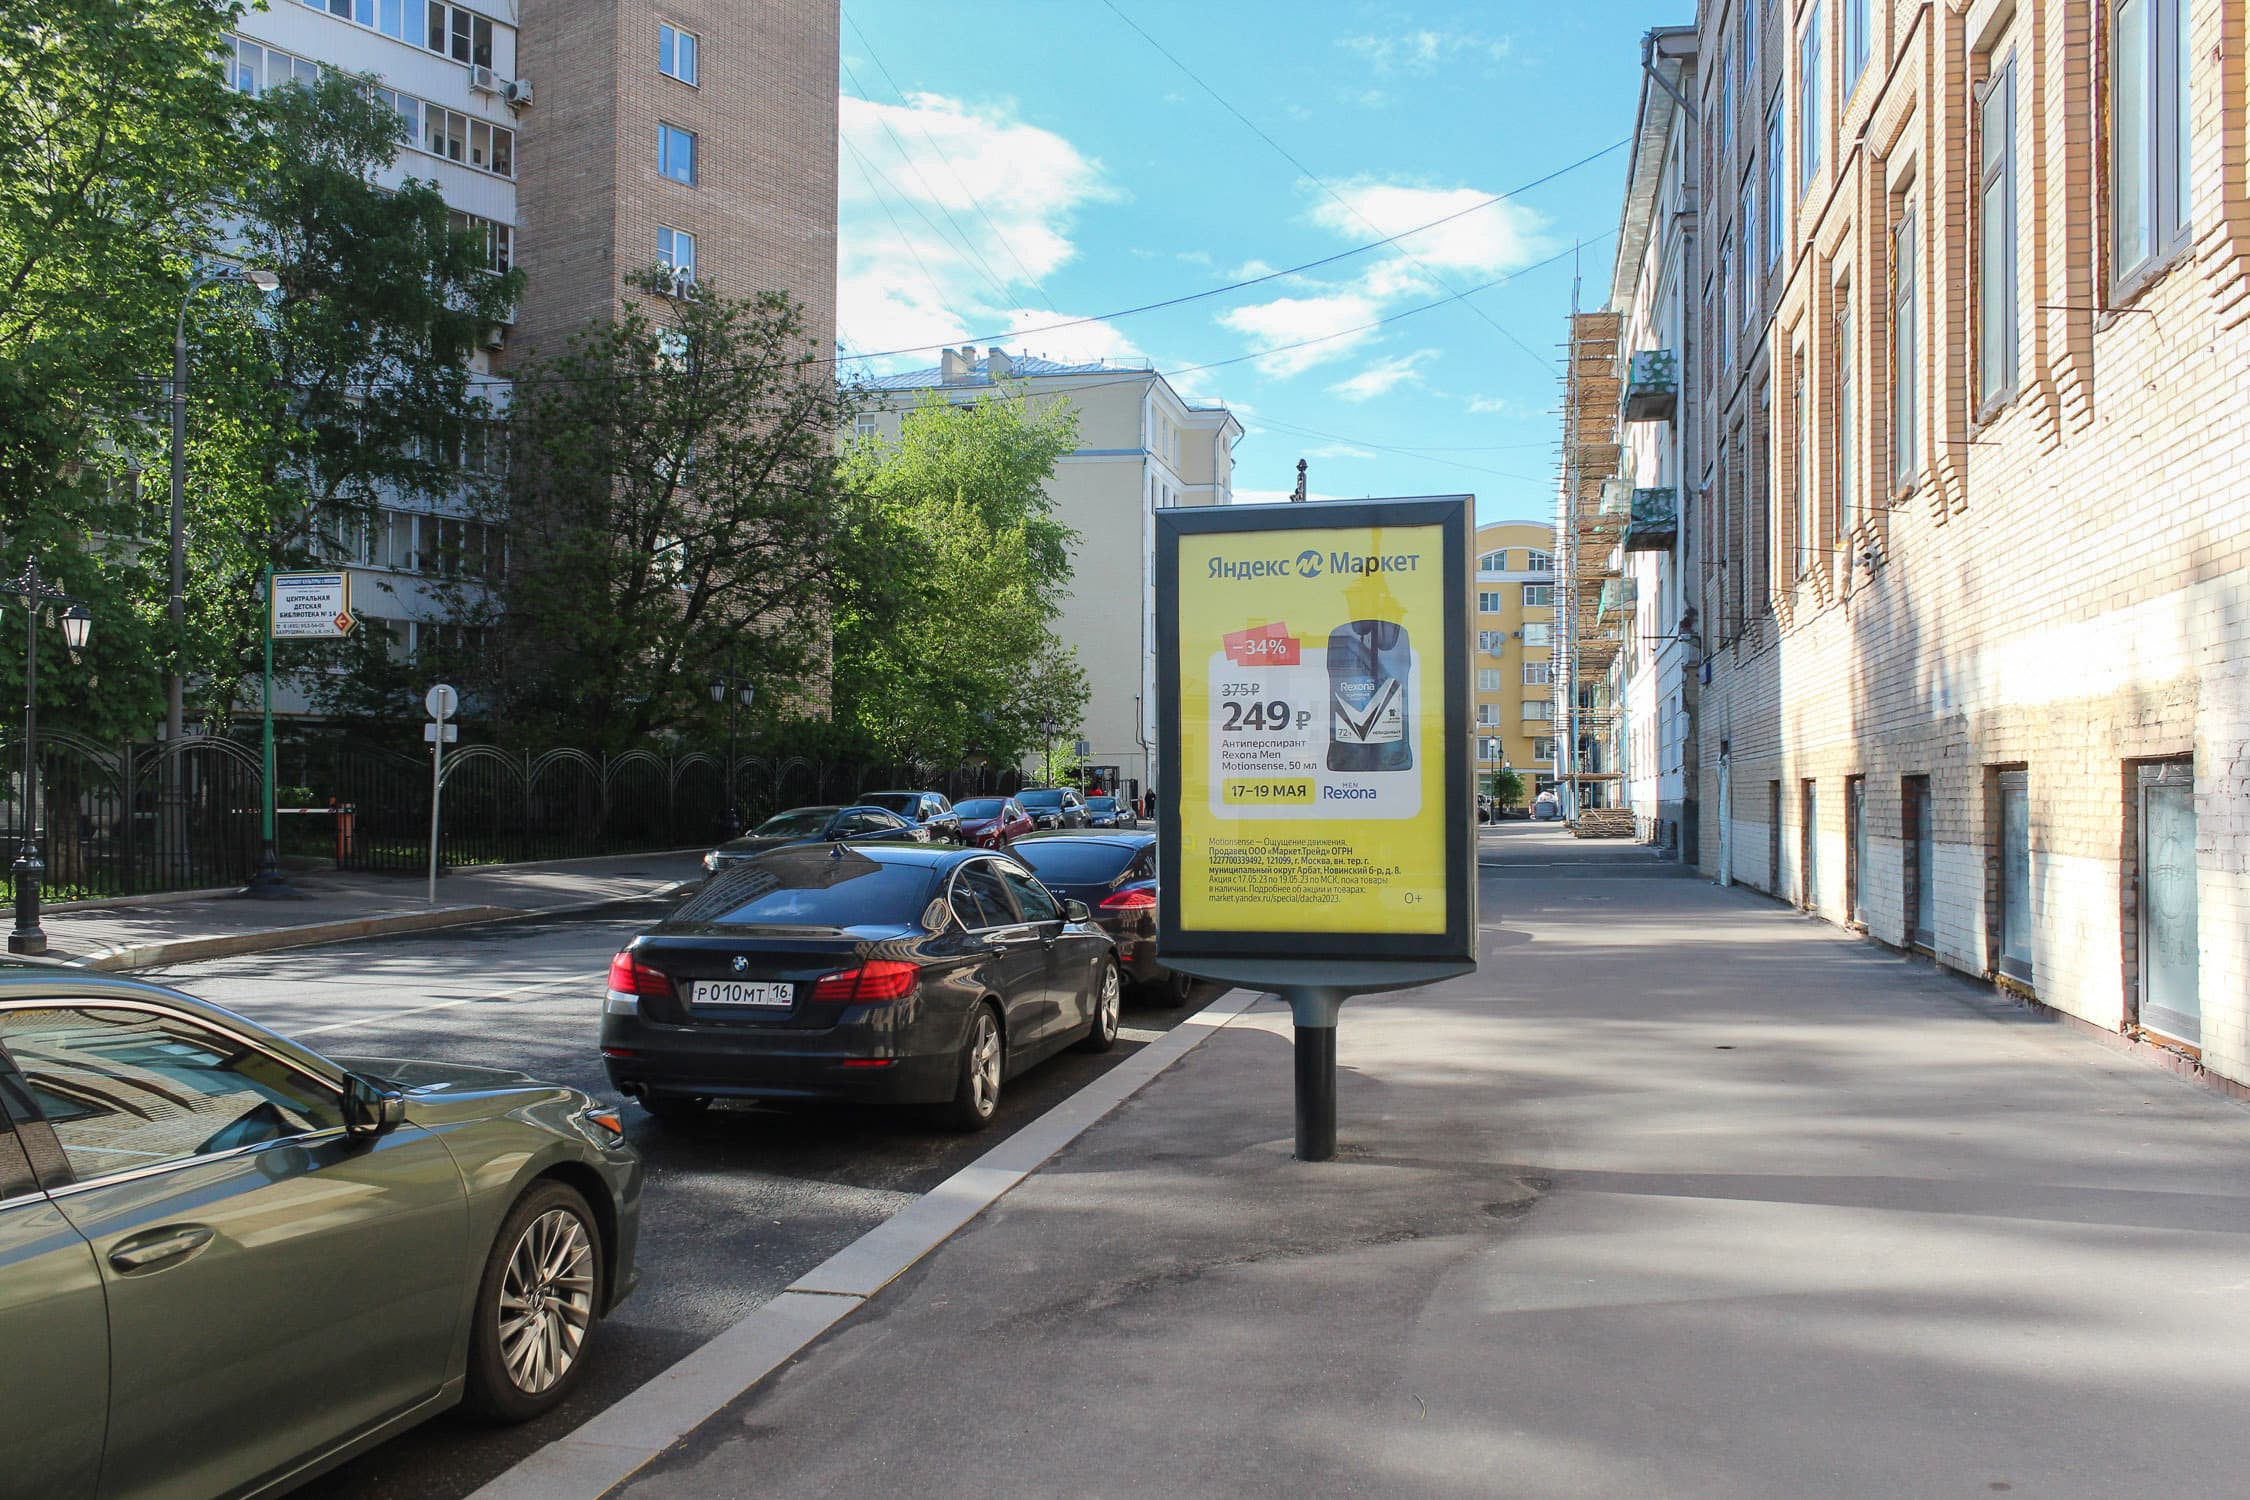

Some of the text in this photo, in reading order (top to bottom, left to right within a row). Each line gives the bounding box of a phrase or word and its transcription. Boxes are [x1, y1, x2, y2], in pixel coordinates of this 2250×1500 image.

[1208, 552, 1420, 580] Яндекс Маркет
[1340, 682, 1375, 692] Rexona
[1222, 700, 1291, 732] 249
[1222, 740, 1306, 749] Антиперспирант
[1222, 751, 1281, 759] Rexona Men
[1222, 761, 1287, 770] Motionsense,
[1289, 761, 1301, 770] 50
[1273, 785, 1307, 797] МАЯ
[1323, 786, 1377, 800] Rexona
[1209, 838, 1254, 846] Motionsense
[1264, 838, 1305, 848] Ощущение
[1209, 847, 1247, 856] Продавец
[1248, 847, 1267, 855] ООО
[1331, 847, 1353, 855] ОГРН
[1301, 857, 1333, 865] Москва,
[1209, 866, 1273, 875] муниципальный
[1274, 867, 1297, 875] округ
[1297, 866, 1322, 875] Арбат,
[1323, 866, 1368, 874] Новинский
[1209, 875, 1232, 884] Акция
[1248, 884, 1291, 893] Подробнее
[1404, 892, 1423, 904] 0+
[772, 985, 788, 999] 16
